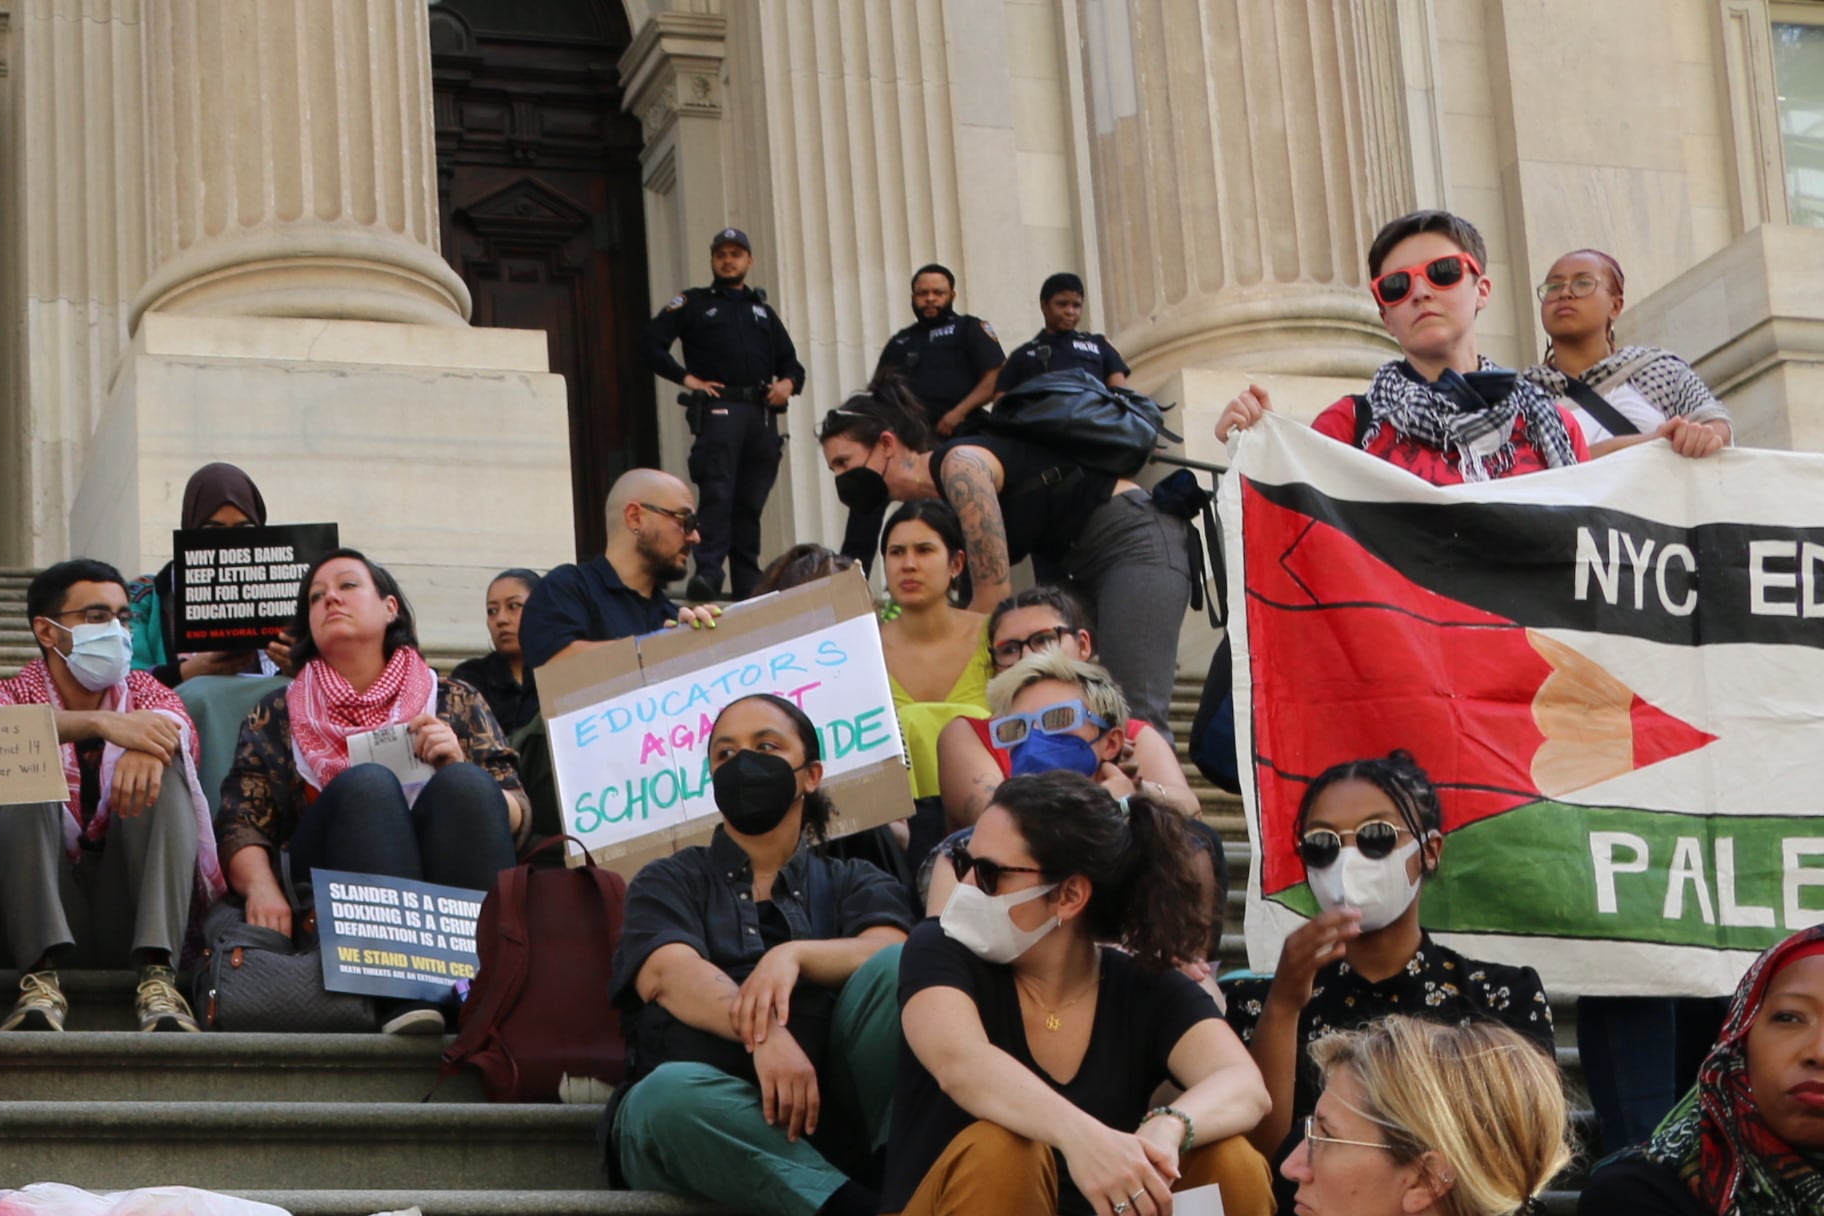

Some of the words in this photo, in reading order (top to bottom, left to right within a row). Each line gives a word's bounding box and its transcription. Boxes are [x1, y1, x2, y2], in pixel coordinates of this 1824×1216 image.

[185, 549, 215, 565] WHY
[219, 548, 251, 564] DOES
[254, 546, 294, 563] BANKS
[185, 568, 215, 584] KEEP
[218, 566, 266, 582] LETTING
[1574, 526, 1698, 617] NYC
[185, 586, 212, 602] RUN
[215, 585, 239, 601] FOR
[185, 602, 255, 620] EDUCATION
[186, 630, 207, 639] END
[210, 627, 258, 638] MAYORAL
[575, 640, 848, 748] EDUCATORS
[29, 739, 40, 755] 14
[329, 882, 400, 906] SLANDER
[403, 891, 418, 908] IS
[423, 895, 434, 912] A
[332, 902, 402, 925] DOXXING
[405, 910, 421, 928] IS
[425, 914, 436, 931] A
[439, 917, 477, 936] CRIM
[334, 921, 417, 944] DEFAMATION
[420, 932, 434, 947] IS
[437, 935, 447, 950] A
[337, 947, 360, 963] WE
[363, 949, 408, 968] STAND
[410, 955, 447, 975] WITH
[449, 962, 475, 979] CEC
[339, 964, 362, 974] DEATH
[363, 966, 391, 977] THREATS
